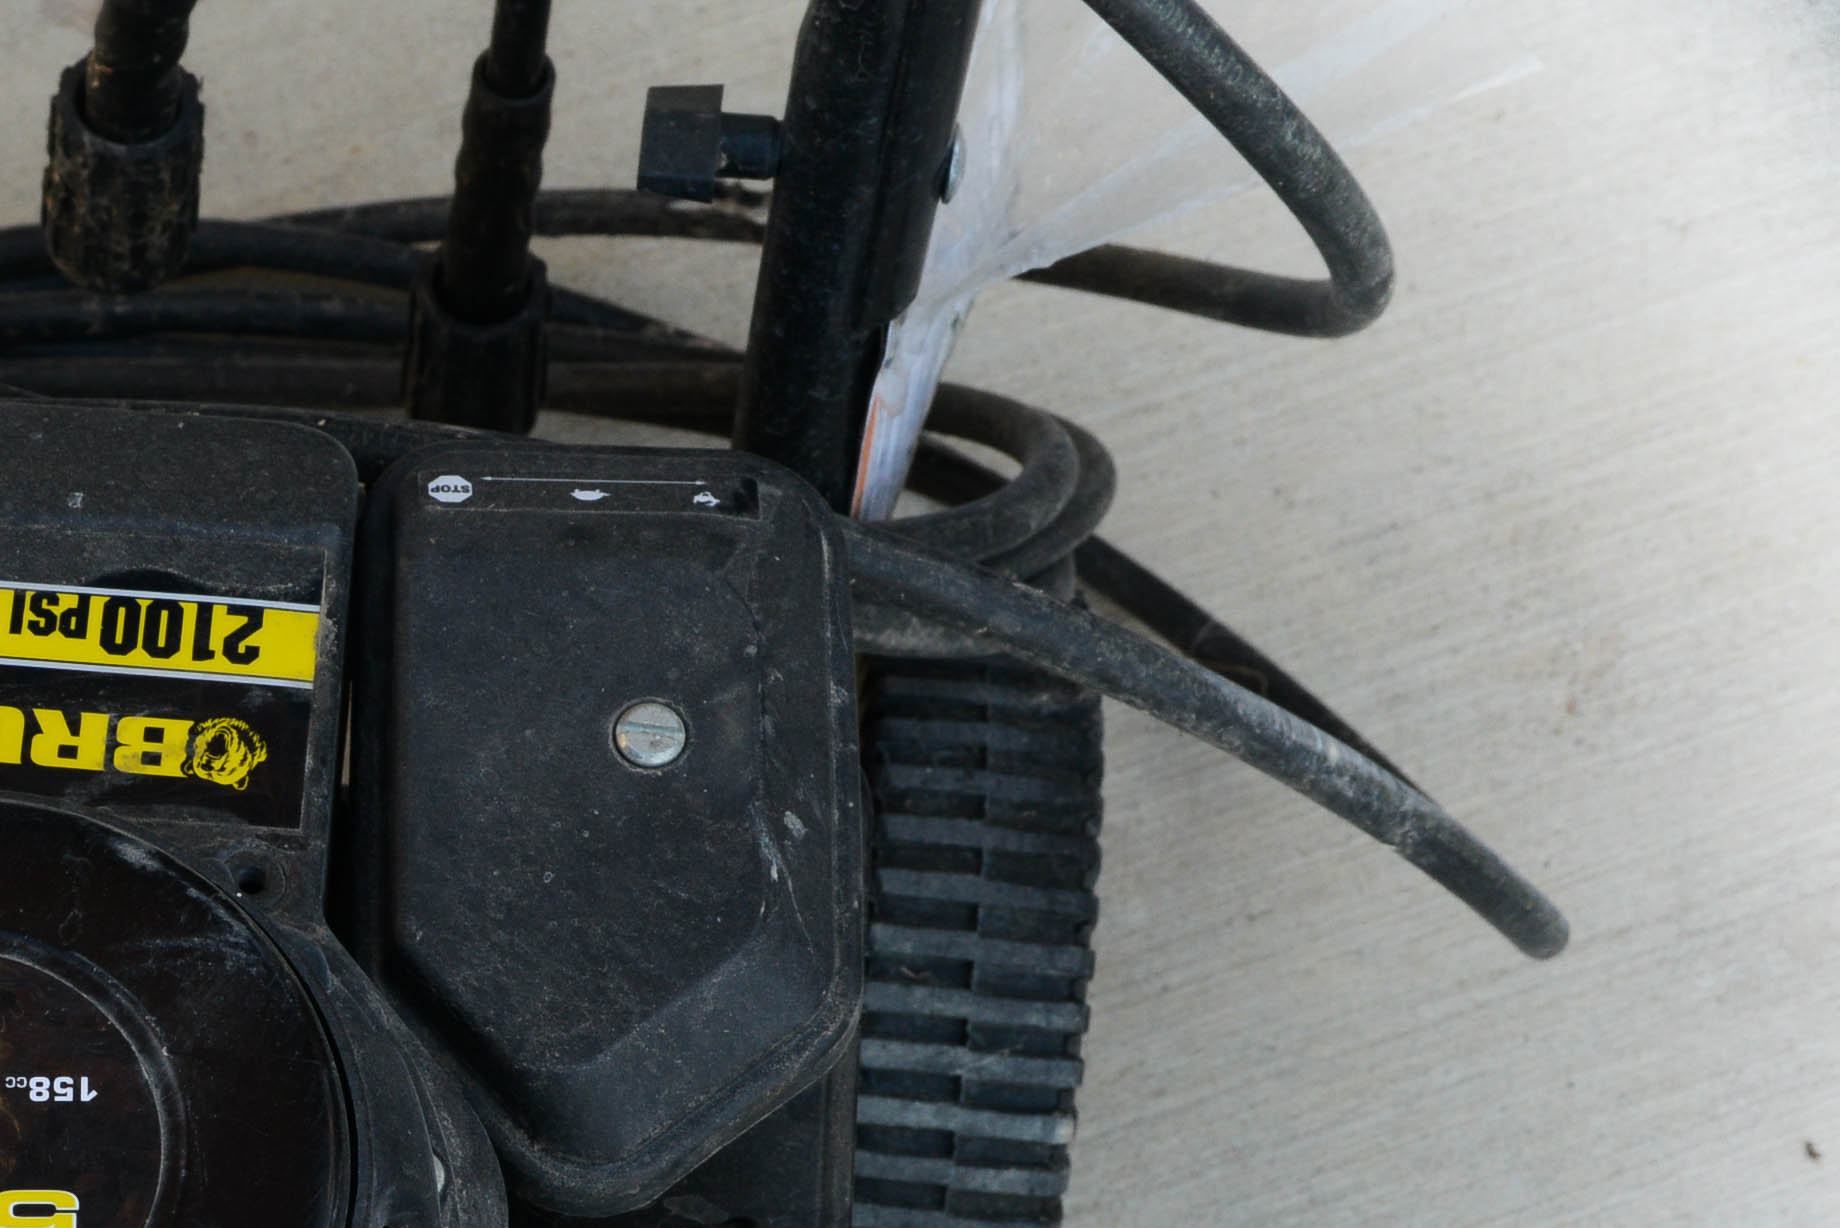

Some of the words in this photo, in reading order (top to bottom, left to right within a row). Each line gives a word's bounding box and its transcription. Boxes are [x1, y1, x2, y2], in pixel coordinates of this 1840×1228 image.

[430, 484, 470, 493] STOP
[9, 590, 91, 639] PSI
[99, 597, 264, 665] 2100
